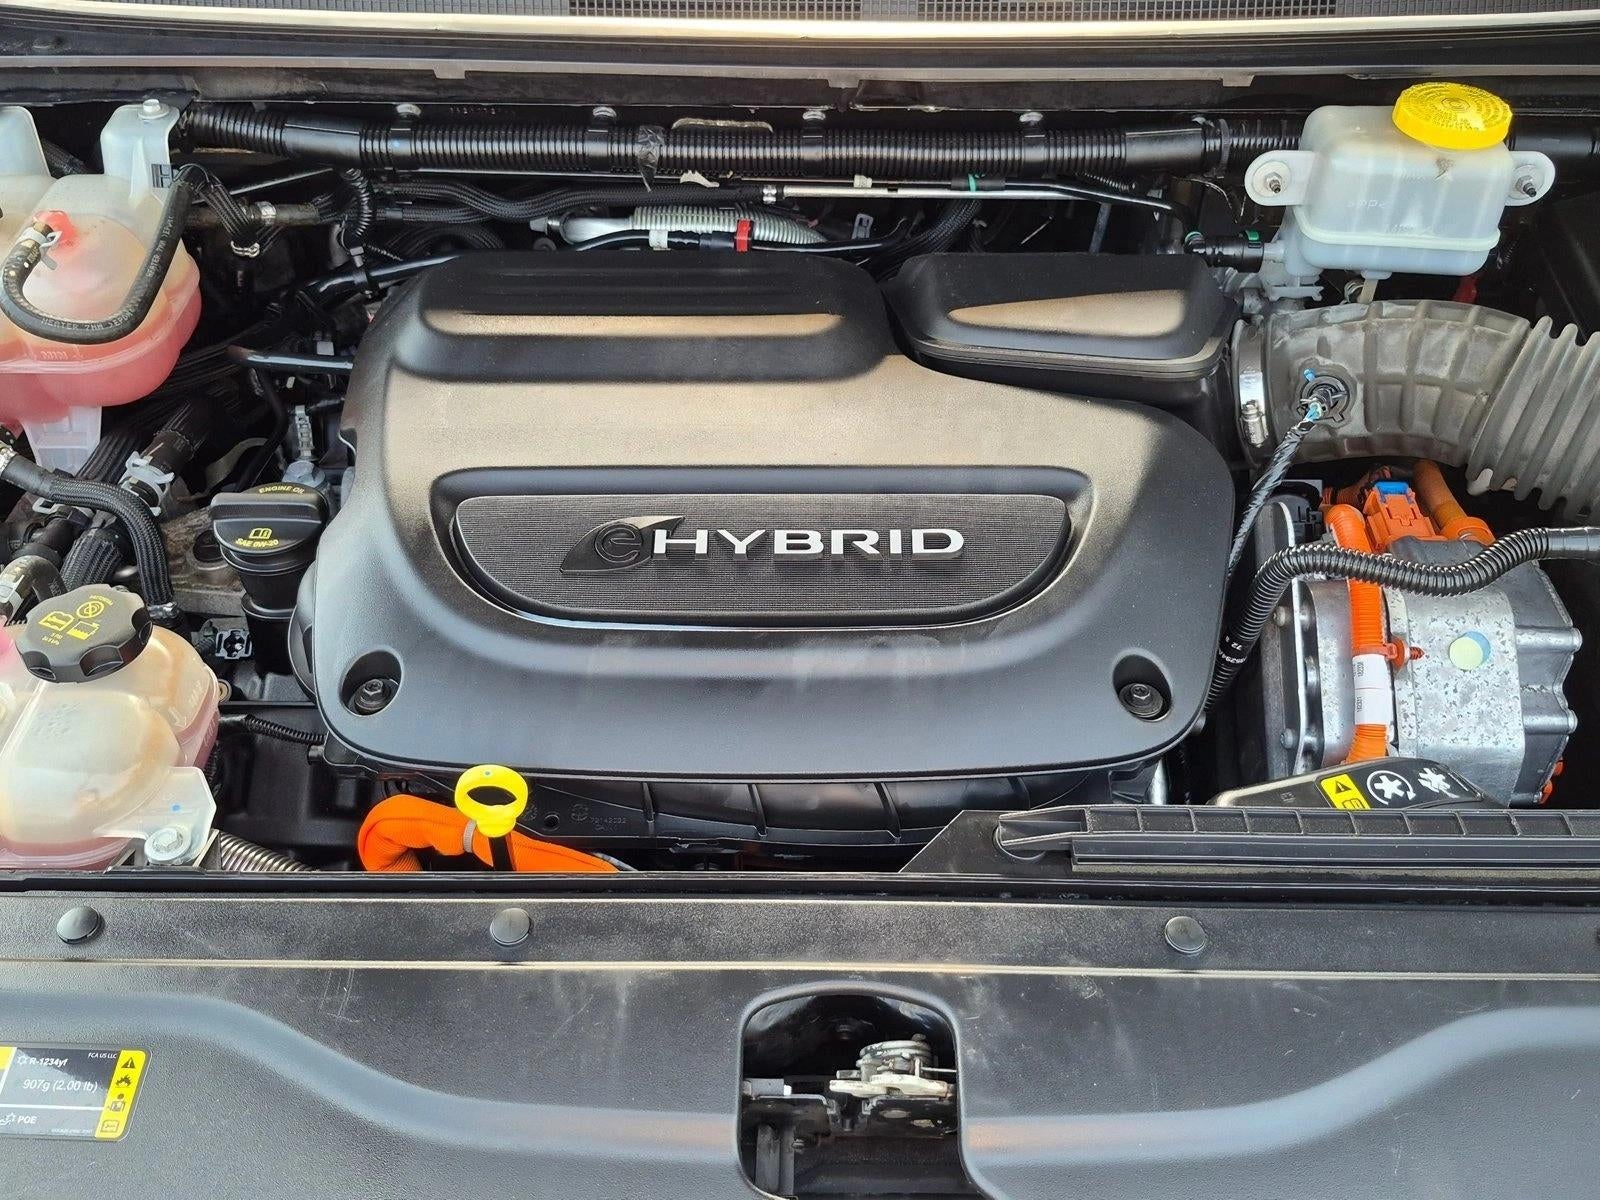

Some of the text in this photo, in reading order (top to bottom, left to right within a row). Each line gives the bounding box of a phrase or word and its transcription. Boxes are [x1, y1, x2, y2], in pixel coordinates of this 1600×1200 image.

[40, 317, 79, 331] HEATER
[258, 485, 305, 494] ENGINE OIL
[235, 538, 279, 548] SAE 0W-20
[653, 529, 966, 560] HYBRID
[29, 1057, 69, 1068] R-1234yf
[22, 1079, 98, 1094] 907g (2.00 lb)
[17, 1115, 38, 1125] POE
